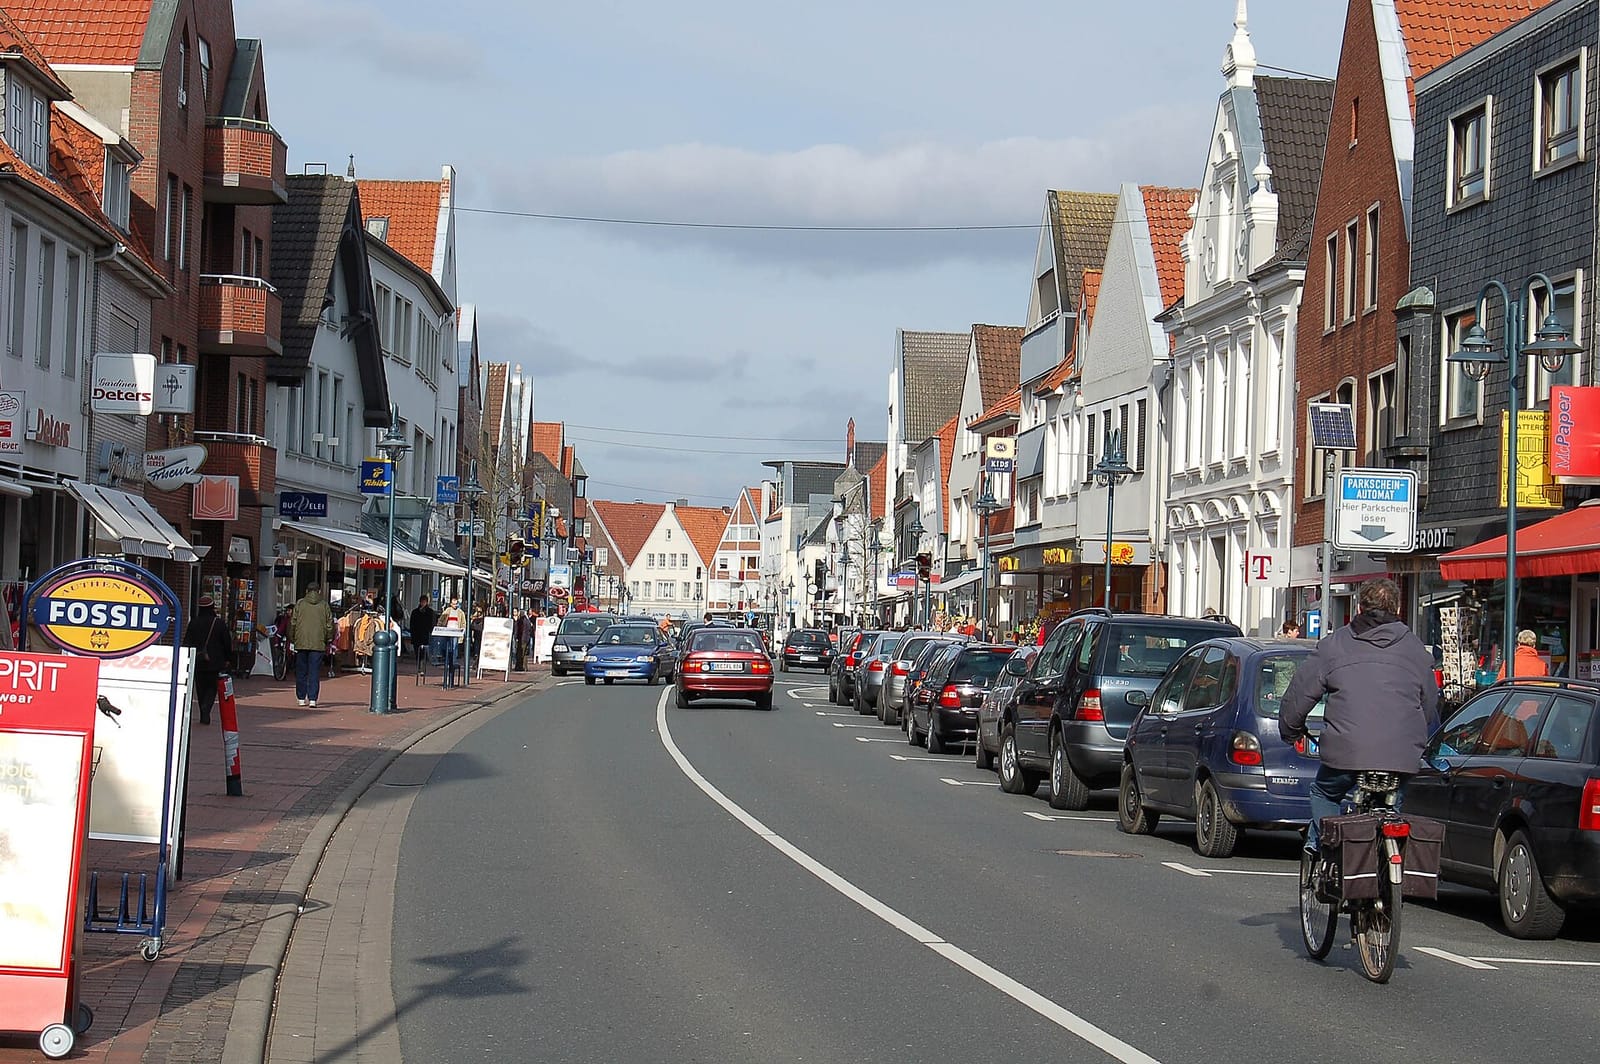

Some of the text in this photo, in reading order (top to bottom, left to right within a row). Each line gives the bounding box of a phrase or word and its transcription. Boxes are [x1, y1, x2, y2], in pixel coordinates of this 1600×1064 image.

[98, 377, 138, 388] Gardinen
[92, 388, 152, 401] Deters
[36, 408, 71, 448] Deters
[1555, 391, 1575, 471] McPaper
[147, 457, 194, 480] Friseur
[990, 460, 1009, 468] KIDS
[363, 479, 391, 487] Tchibo
[1347, 478, 1405, 490] PARKSCHEIN-
[1356, 490, 1395, 500] AUTOMAT
[1341, 503, 1408, 513] Hier Parkschein
[1361, 513, 1386, 522] lösen
[1252, 556, 1272, 580] T
[62, 580, 146, 600] AUTHENTIC
[50, 600, 158, 629] FOSSIL
[0, 693, 33, 704] wear
